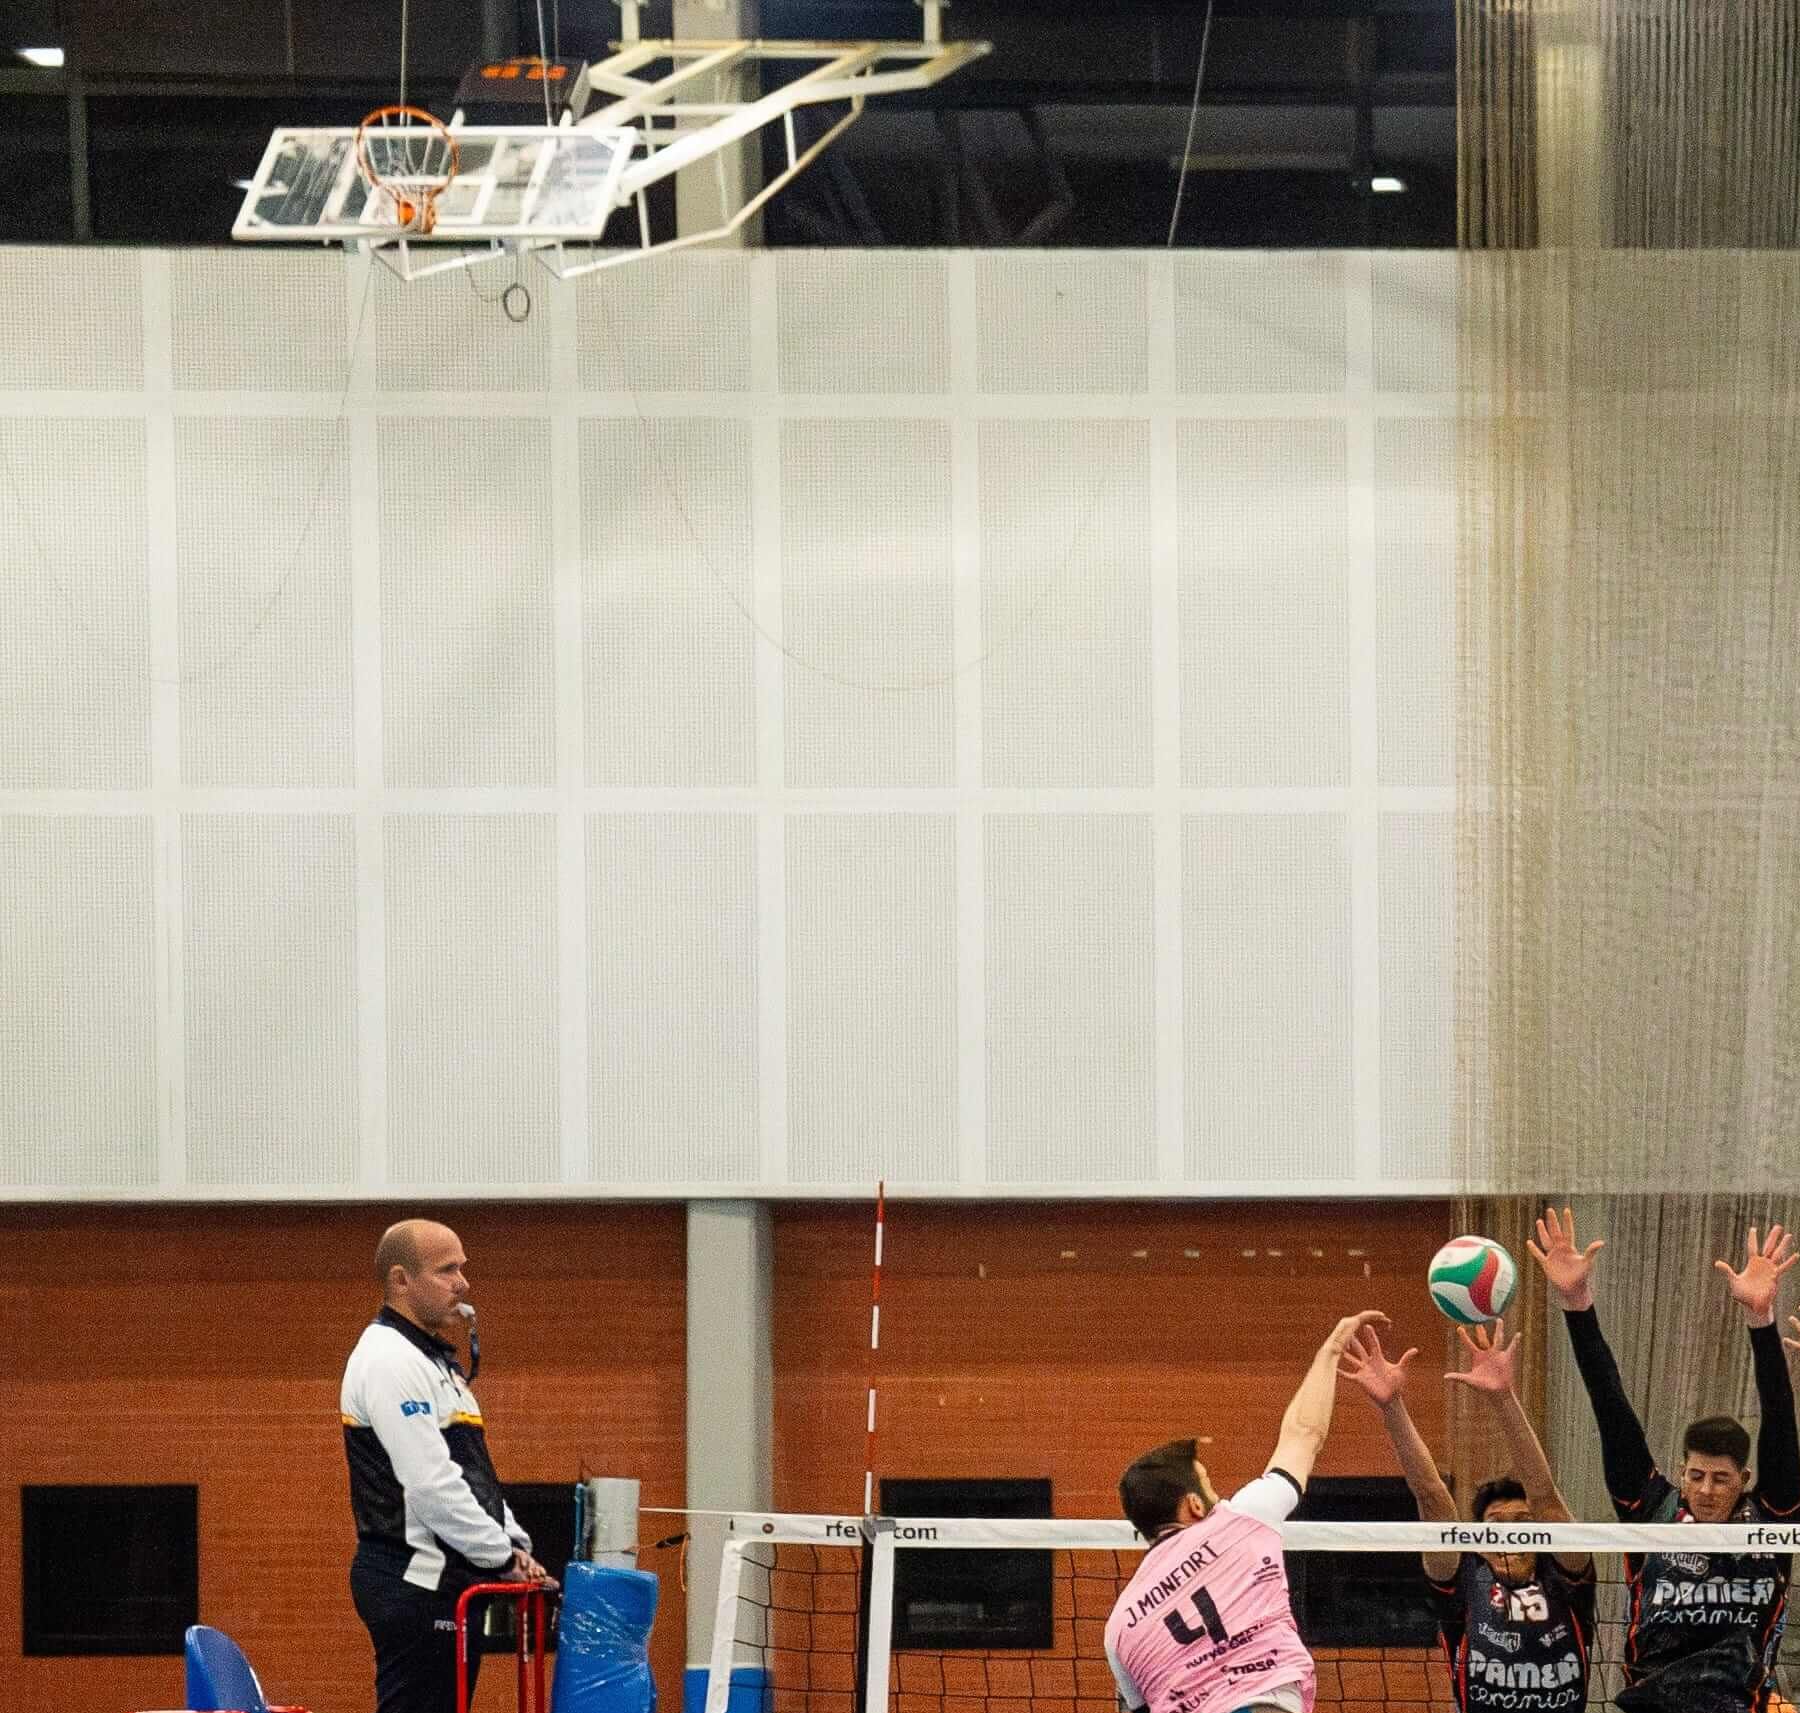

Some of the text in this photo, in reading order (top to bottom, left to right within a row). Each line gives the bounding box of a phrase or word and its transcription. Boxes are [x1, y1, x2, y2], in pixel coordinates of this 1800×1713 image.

[1441, 1528, 1552, 1546] rfevb.com
[1127, 1541, 1219, 1629] J.MONFORT
[1508, 1584, 1550, 1622] 15
[1164, 1585, 1229, 1646] 4
